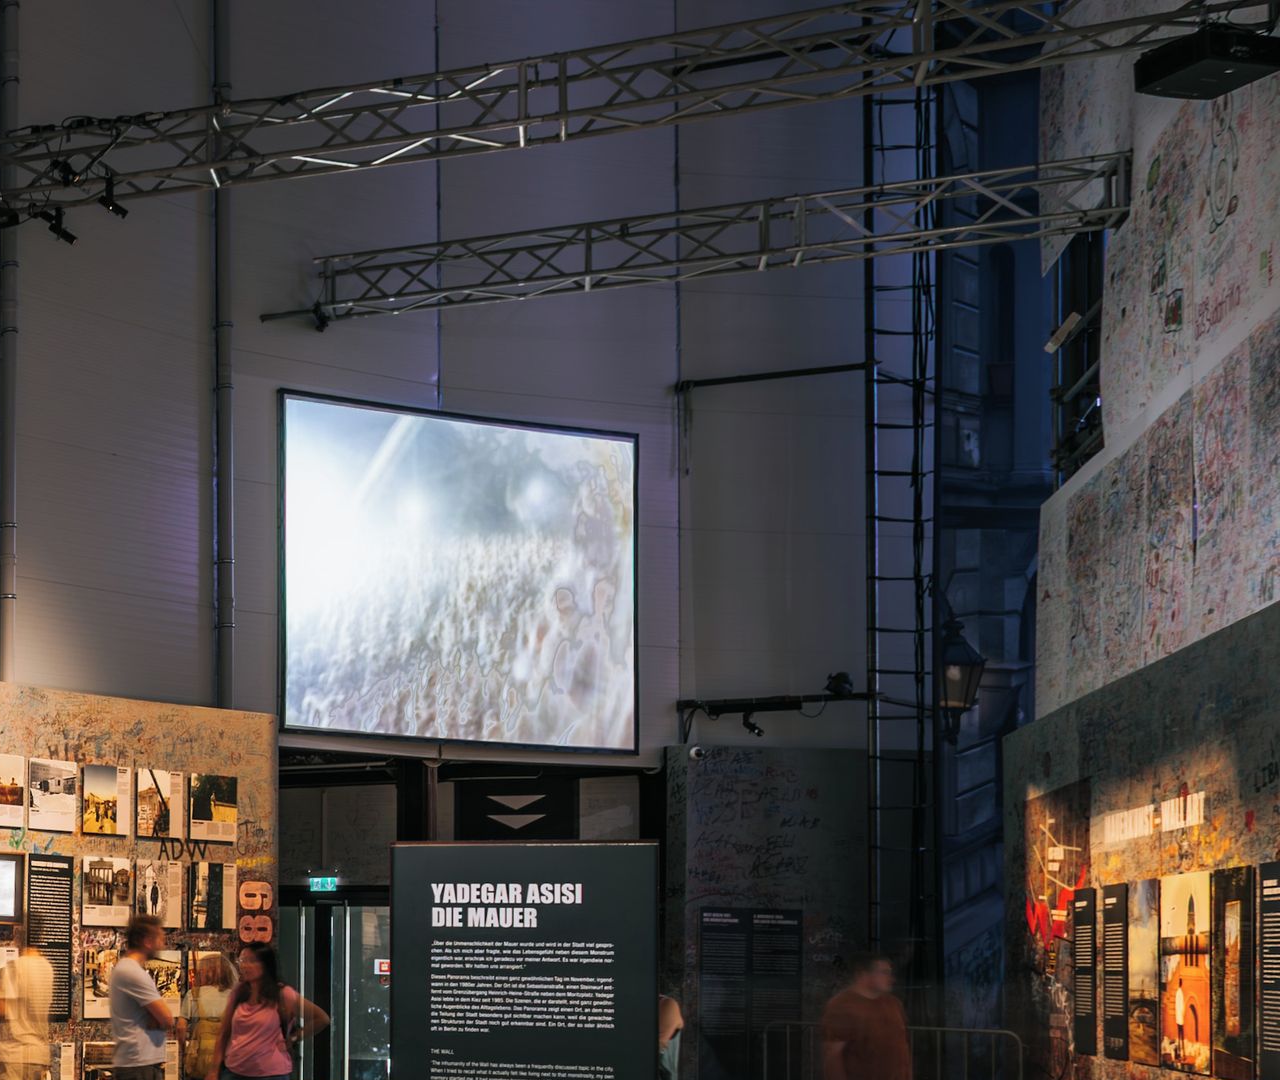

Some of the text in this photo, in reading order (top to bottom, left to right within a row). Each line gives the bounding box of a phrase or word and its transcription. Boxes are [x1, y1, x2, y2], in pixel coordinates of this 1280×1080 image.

[431, 883, 582, 904] YADEGAR ASISI
[431, 907, 538, 928] DIE MAUER
